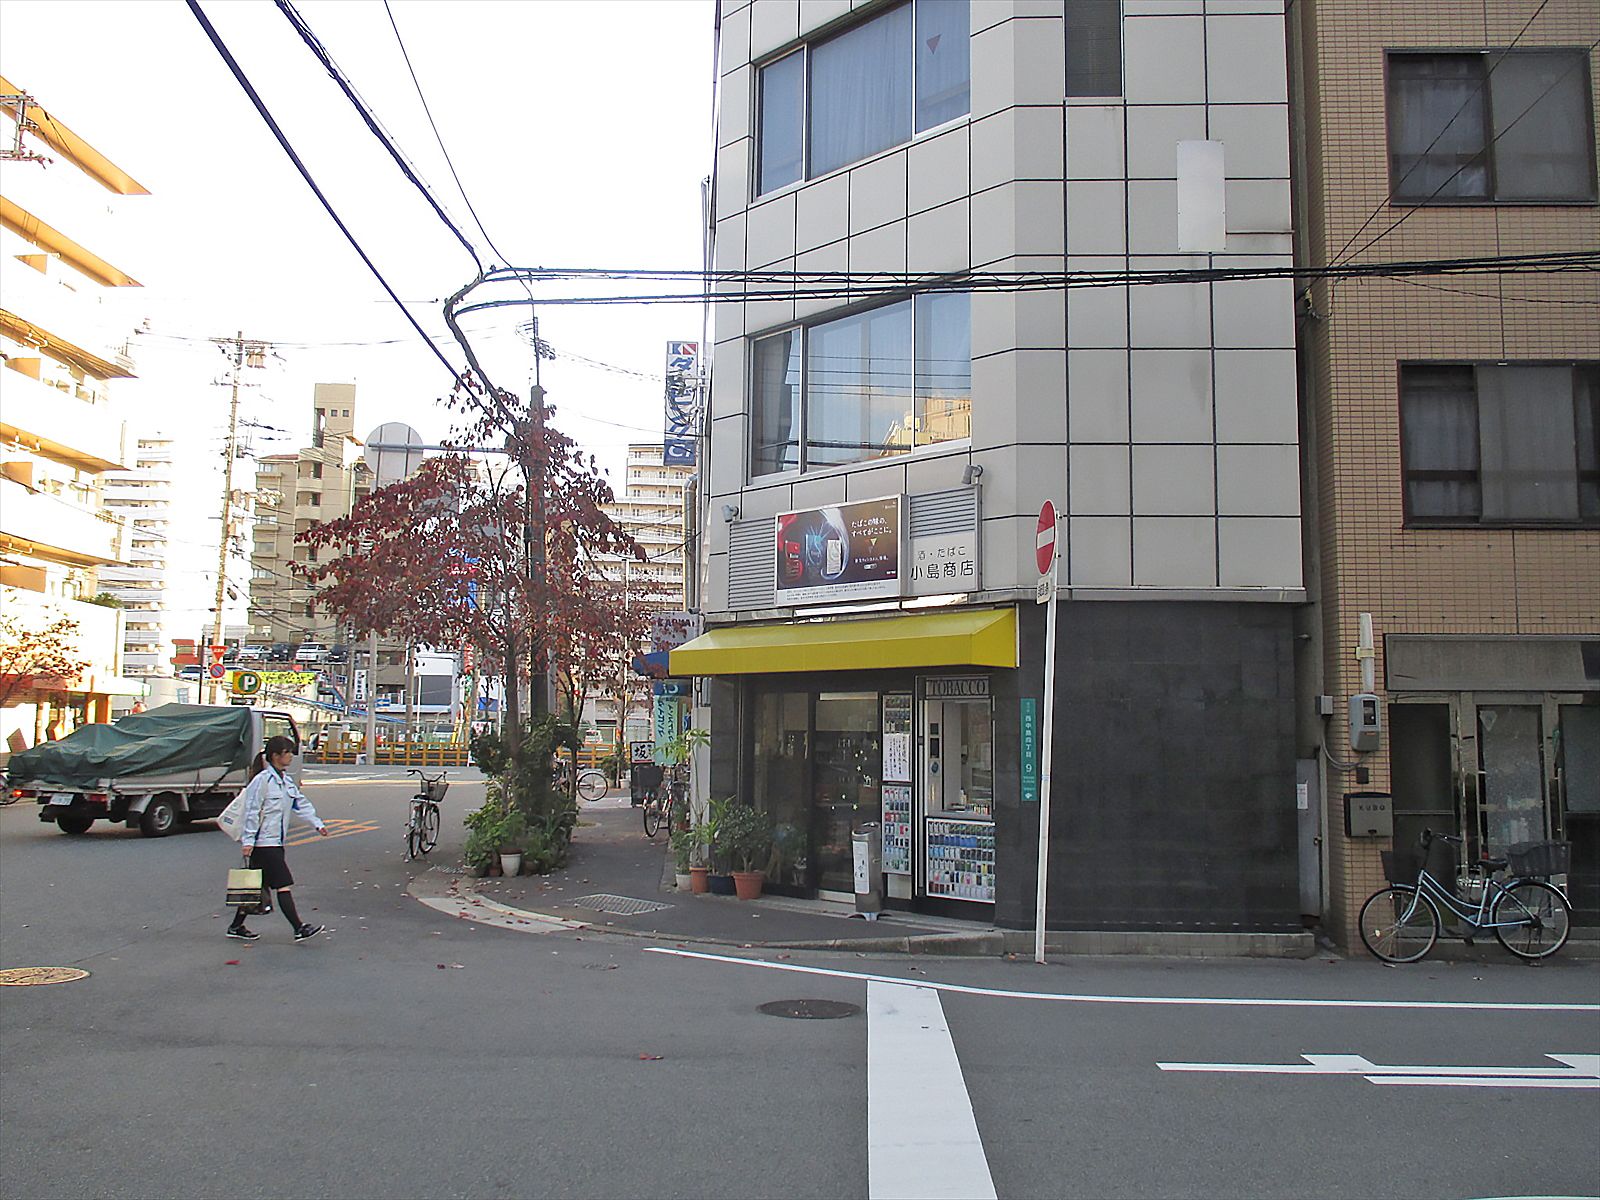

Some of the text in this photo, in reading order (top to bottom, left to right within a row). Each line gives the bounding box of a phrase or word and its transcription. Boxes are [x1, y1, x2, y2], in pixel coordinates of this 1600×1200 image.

[910, 560, 974, 580] 小島商店
[243, 675, 256, 690] P
[928, 680, 986, 696] TOBACCO
[1025, 763, 1033, 773] 9
